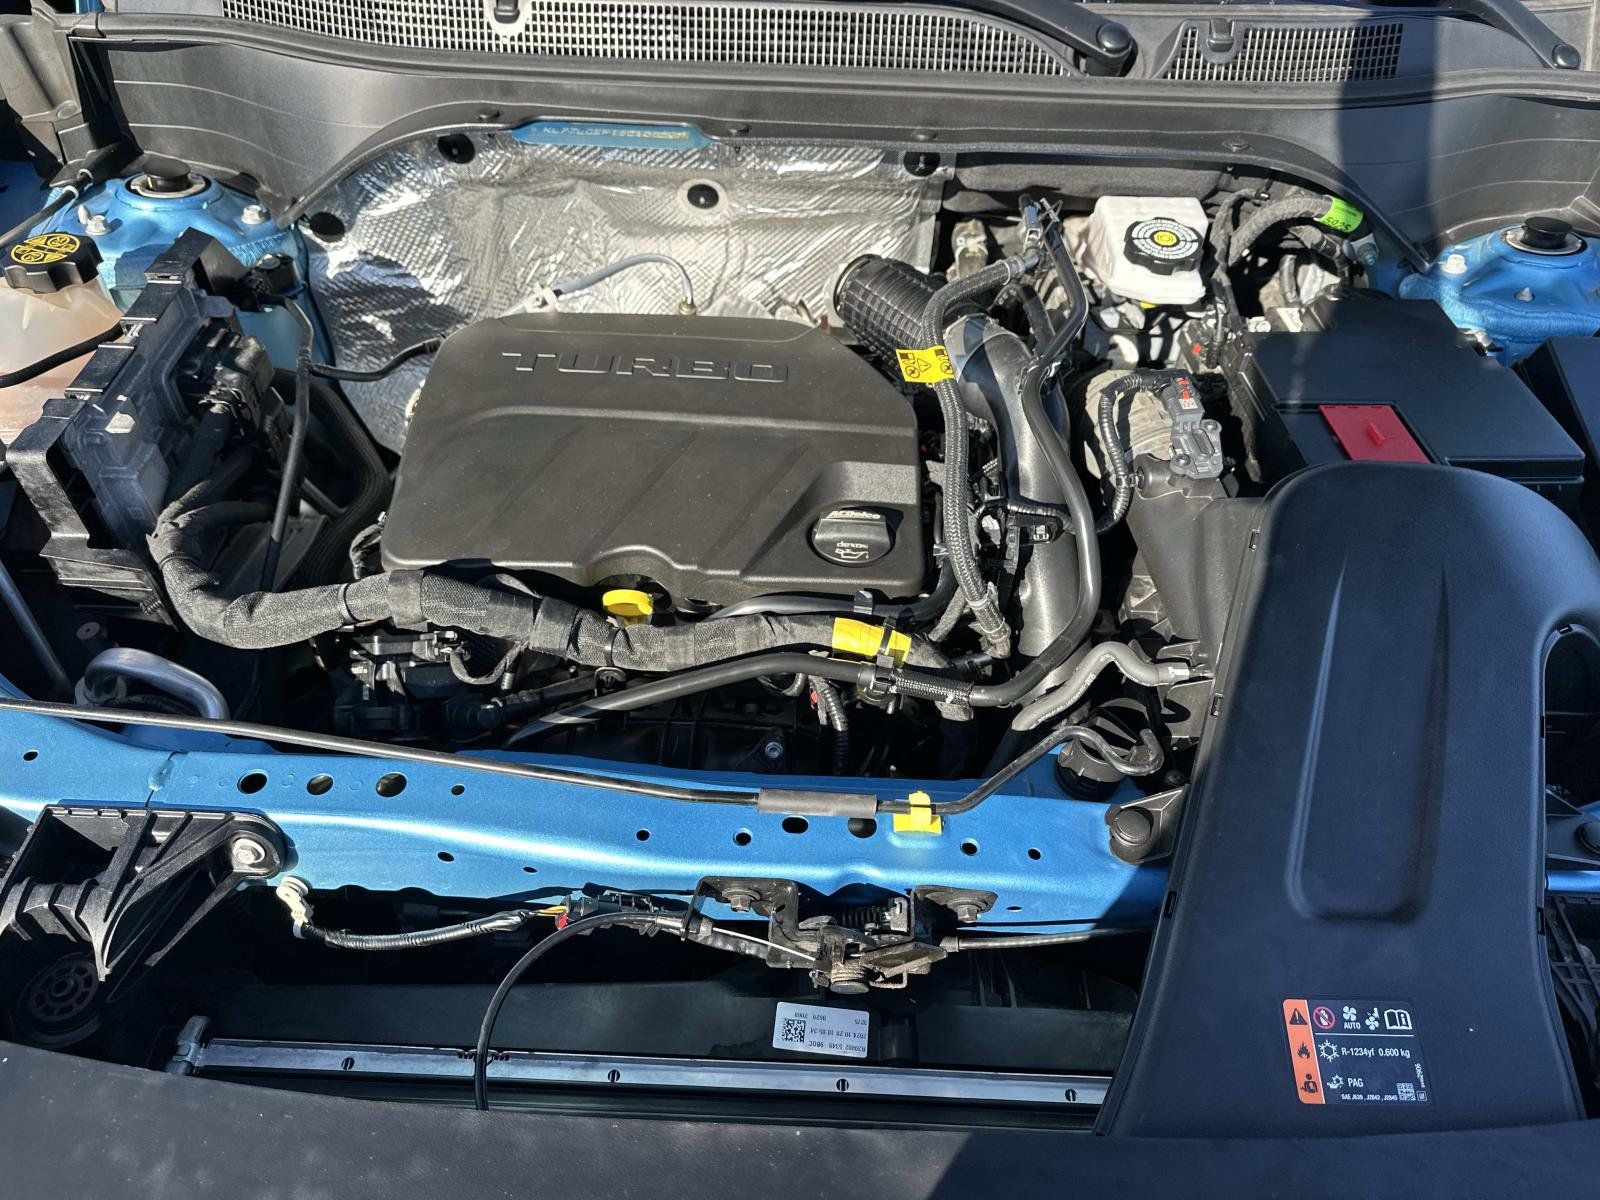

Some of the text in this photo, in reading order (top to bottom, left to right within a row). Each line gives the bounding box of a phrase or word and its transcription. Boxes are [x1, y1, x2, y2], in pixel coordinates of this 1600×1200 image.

[501, 351, 790, 384] TURBO
[826, 510, 881, 519] ACDelco
[836, 541, 869, 549] dexos
[1343, 1022, 1361, 1030] AUTO
[1341, 1047, 1411, 1059] R-1234yf 0.600 kg
[1347, 1077, 1364, 1087] PAG
